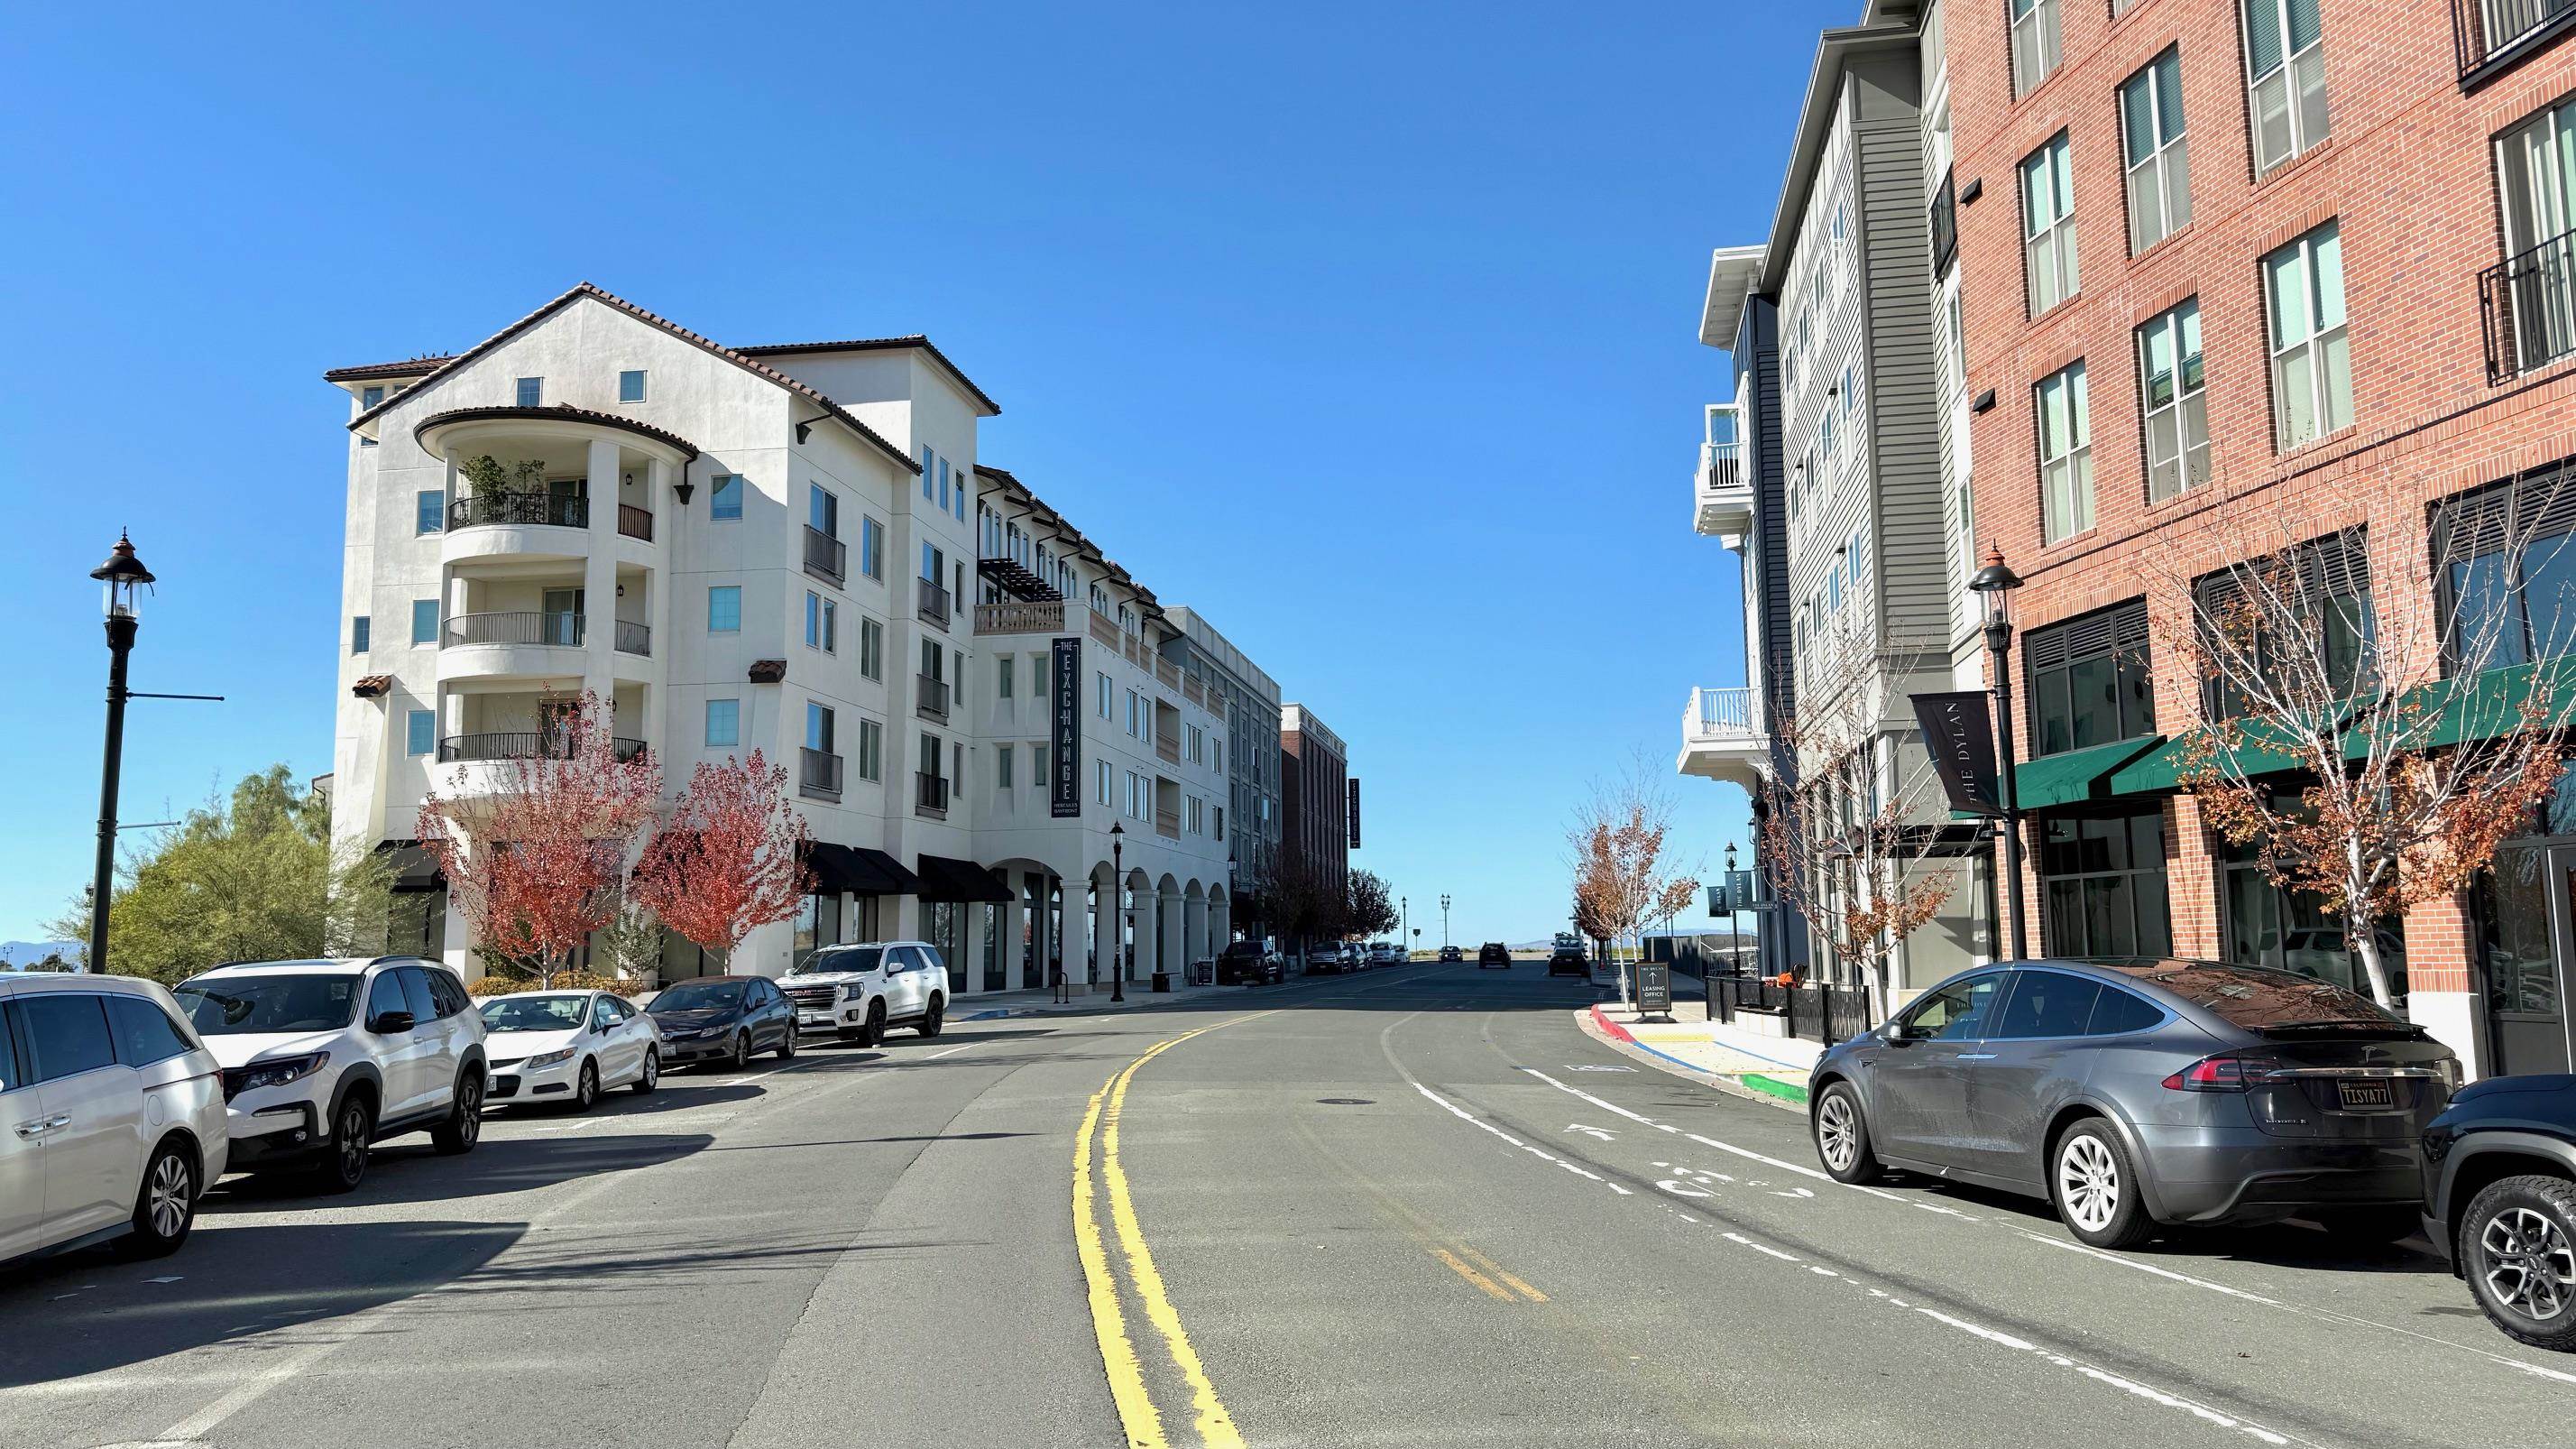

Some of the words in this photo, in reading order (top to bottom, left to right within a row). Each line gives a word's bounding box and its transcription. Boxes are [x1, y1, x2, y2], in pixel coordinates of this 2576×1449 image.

[1060, 641, 1073, 651] THE
[1060, 654, 1073, 799] EXCHANGE
[1946, 701, 1970, 761] DYLAN
[1961, 770, 1978, 804] THE
[2342, 1089, 2387, 1103] TISYA77
